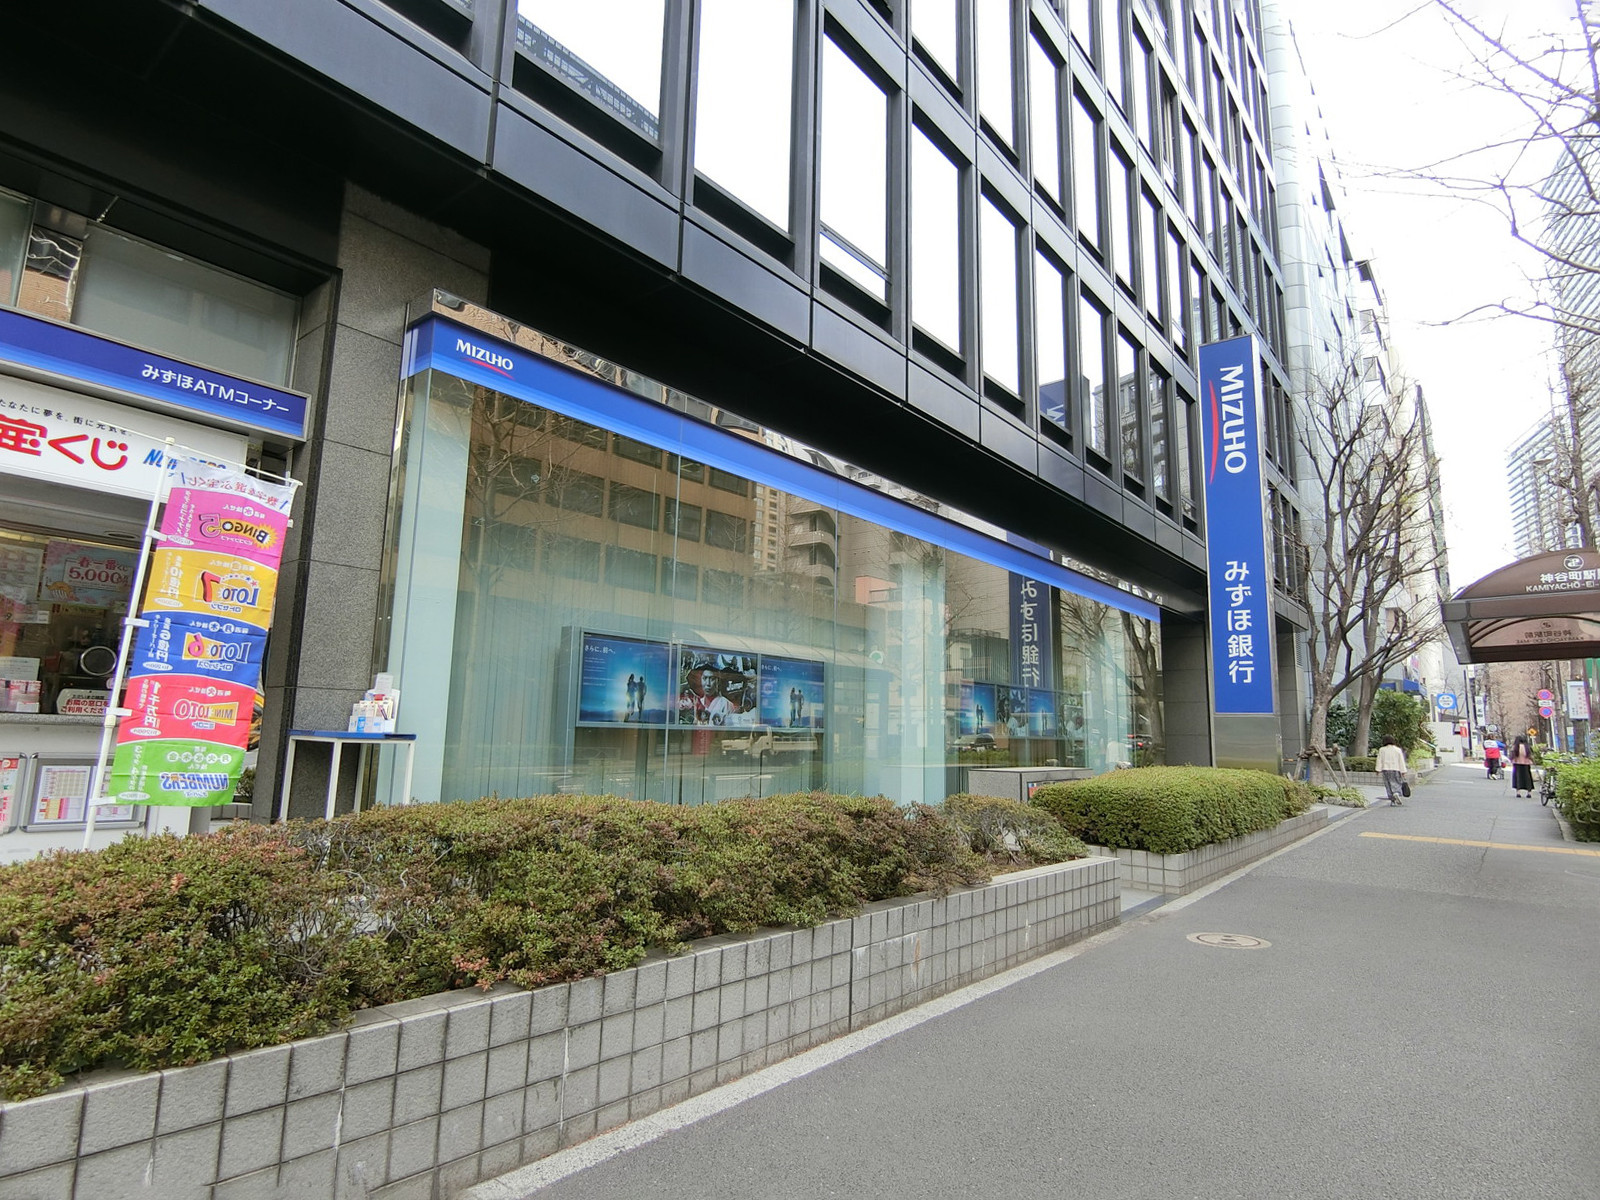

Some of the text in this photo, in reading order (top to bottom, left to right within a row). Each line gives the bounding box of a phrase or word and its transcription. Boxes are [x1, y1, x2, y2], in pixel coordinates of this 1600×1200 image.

[141, 363, 290, 413] みずほATMコーナー
[456, 338, 514, 371] MIZUHO
[1219, 363, 1247, 475] MIZUHO
[1224, 560, 1255, 684] みずほ銀行
